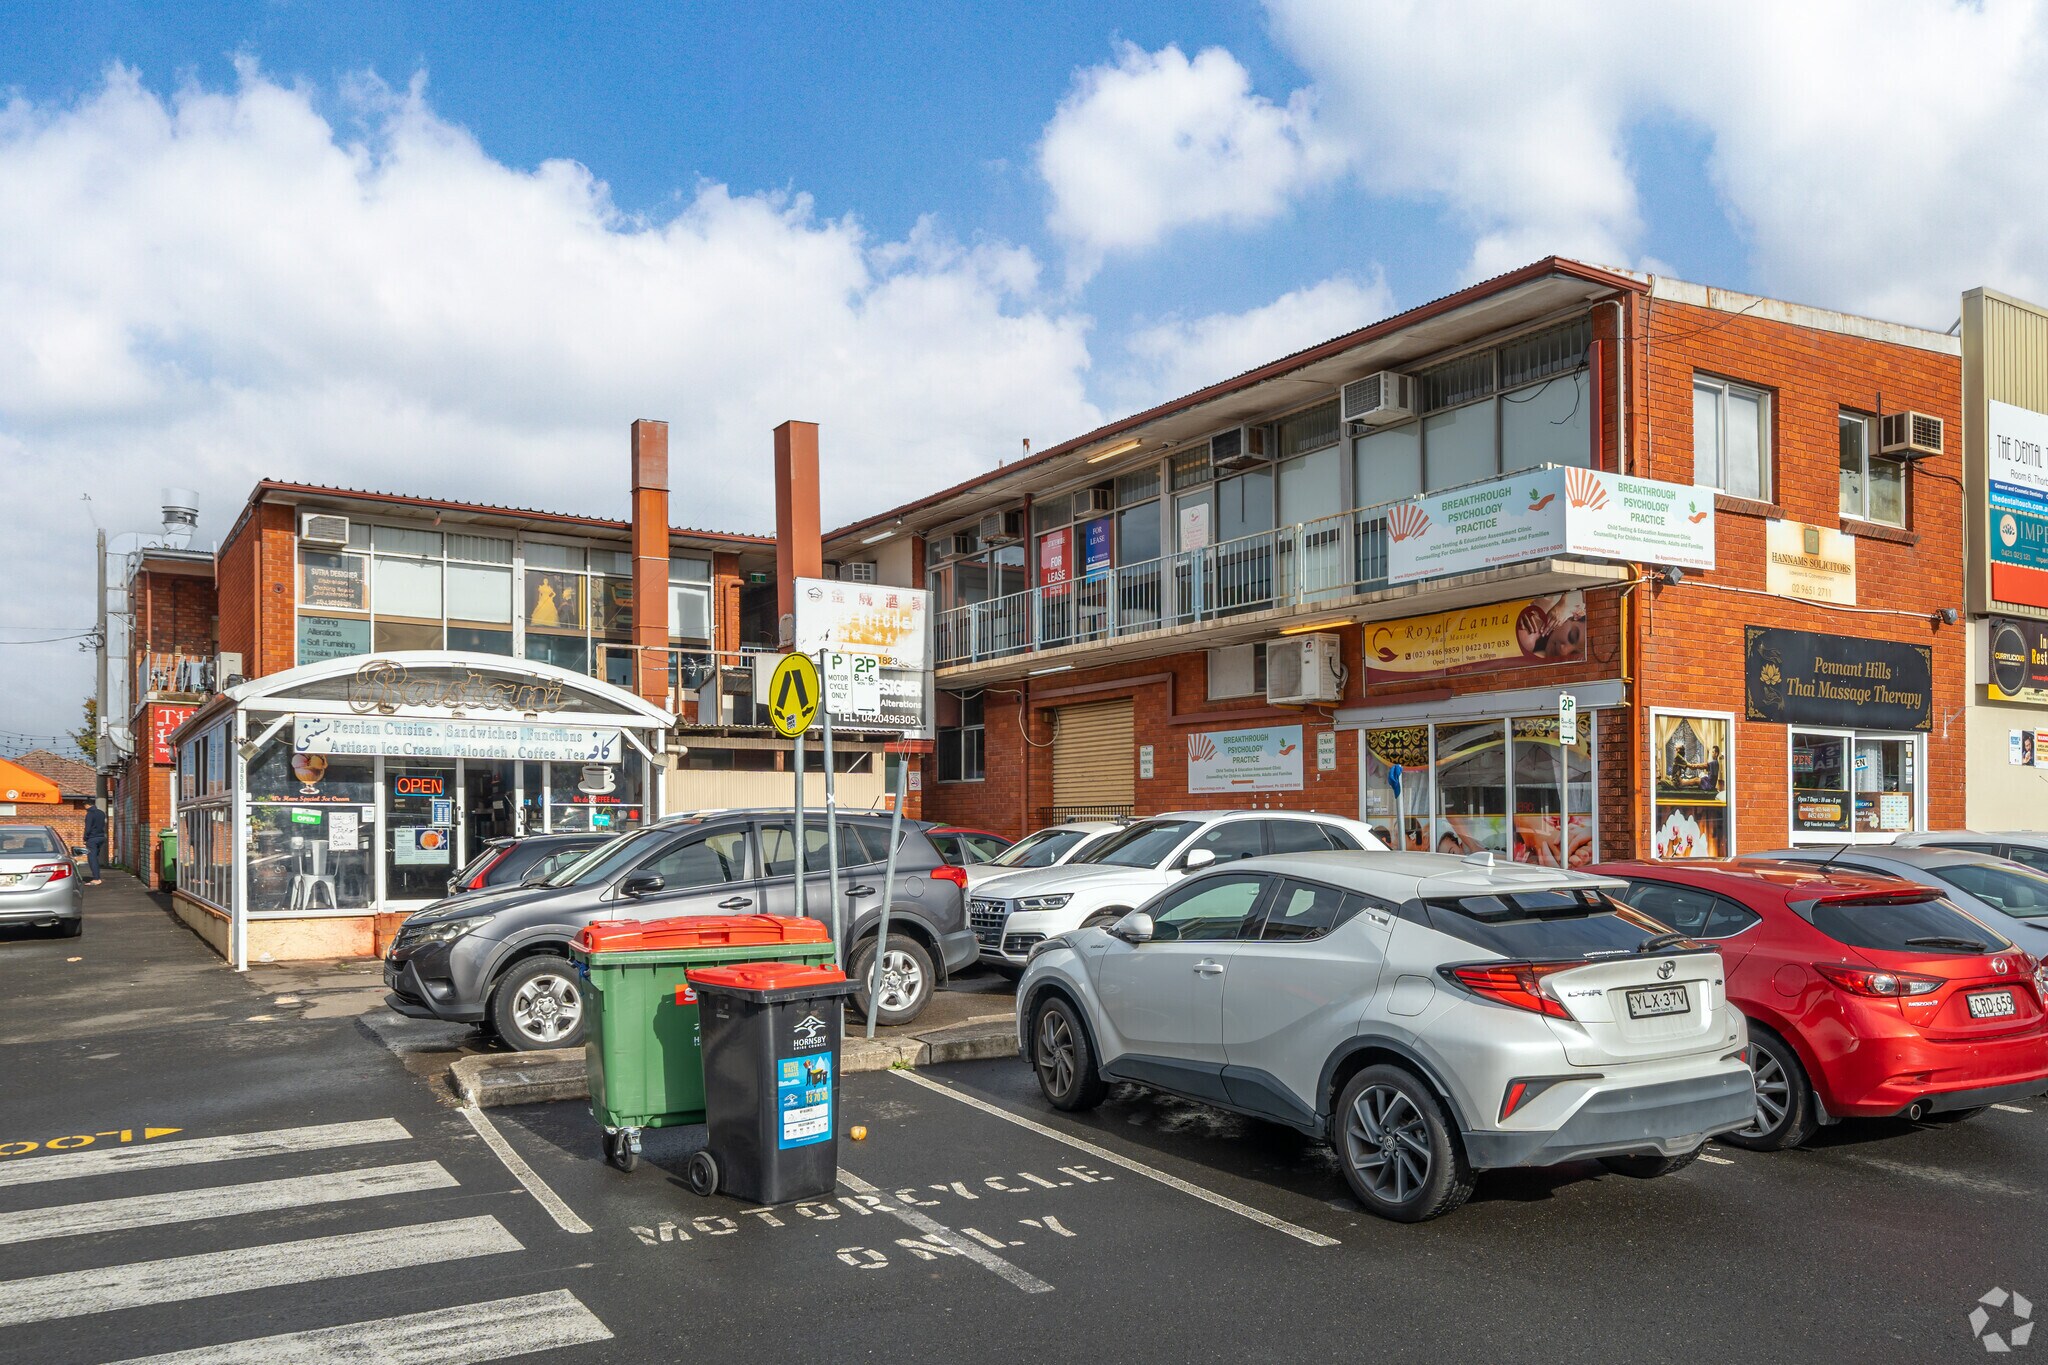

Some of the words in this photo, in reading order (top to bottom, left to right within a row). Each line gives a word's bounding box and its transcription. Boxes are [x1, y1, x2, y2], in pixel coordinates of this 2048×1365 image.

[1997, 434, 2011, 461] THE
[2014, 439, 2042, 469] DENTAL
[2010, 468, 2027, 481] Room
[1618, 482, 1676, 501] BREAKTHROUGH
[1994, 483, 2008, 491] General
[1441, 486, 1512, 512] BREAKTHROUGH
[1624, 498, 1669, 513] PSYCHOLOGY
[1448, 503, 1503, 523] PSYCHOLOGY
[1630, 513, 1665, 526] PRACTICE
[1092, 526, 1103, 535] FOR
[1455, 518, 1497, 535] PRACTICE
[1607, 524, 1618, 532] Child
[1618, 526, 1633, 534] Testing
[1637, 528, 1657, 536] Education
[1657, 531, 1680, 539] Assessment
[1090, 535, 1105, 545] LEASE
[1430, 543, 1441, 551] Child
[1441, 540, 1458, 549] Testing
[1464, 535, 1487, 545] Education
[1488, 529, 1517, 540] Assessment
[1517, 525, 1532, 533] Clinic
[1593, 530, 1617, 540] Counselling
[1688, 542, 1704, 550] Families
[1415, 551, 1441, 562] Counselling
[1501, 536, 1517, 545] Adults
[1528, 530, 1549, 540] Families
[1550, 543, 1563, 551] 0600
[1051, 556, 1062, 568] FOR
[1772, 551, 1808, 567] HANNAMS
[1809, 557, 1852, 574] SOLICITORS
[1047, 569, 1066, 583] LEASE
[1791, 583, 1800, 593] 02
[1801, 585, 1816, 595] 9651
[1818, 587, 1832, 598] 2711
[308, 618, 338, 629] Tailoring
[1404, 616, 1451, 641] Royal
[1458, 612, 1511, 632] Lanna
[307, 628, 342, 638] Alterations
[1431, 635, 1447, 645] Thai
[1449, 632, 1479, 644] Massage
[307, 639, 320, 648] Soft
[322, 640, 356, 651] Furnishing
[1412, 651, 1426, 661] (02)
[1427, 648, 1443, 658] 9446
[1444, 646, 1460, 656] 9859
[1465, 643, 1482, 653] 0422
[1483, 641, 1496, 650] 017
[1497, 640, 1511, 649] 038
[307, 650, 332, 659] Invisible
[1432, 659, 1445, 668] Open
[1449, 656, 1461, 666] Days
[1466, 654, 1477, 662] 9am
[1994, 651, 2026, 663] CURRYLICIOUS
[832, 655, 843, 670] P
[854, 657, 878, 673] 2P
[1814, 657, 1863, 677] Pennant
[1865, 661, 1893, 680] Hills
[347, 659, 568, 713] Bastani
[1786, 677, 1816, 698] Thai
[1817, 681, 1871, 706] Massage
[1873, 685, 1923, 710] Therapy
[880, 699, 922, 710] Alterations
[1562, 699, 1574, 711] 2P
[861, 711, 916, 725] 0420496305
[333, 720, 380, 737] Persian
[384, 722, 433, 739] Cuisine
[446, 724, 518, 741] Sandwiches
[527, 728, 583, 743] Functions
[1223, 733, 1269, 745] BREAKTHROUGH
[1319, 738, 1333, 746] TENANT
[330, 741, 377, 754] Artisan
[381, 743, 399, 755] Ice
[403, 744, 443, 757] Cream
[454, 744, 508, 759] Faloodeh
[518, 746, 556, 760] Coffee
[565, 748, 586, 761] Tea
[1227, 745, 1264, 755] PSYCHOLOGY
[1318, 748, 1335, 756] PARKING
[1232, 755, 1260, 765] PRACTICE
[1793, 755, 1811, 765] PEN
[397, 778, 443, 794] OPEN
[297, 816, 316, 824] OPEN
[793, 1035, 827, 1050] HORNSBY
[836, 1215, 1077, 1270] ONLY
